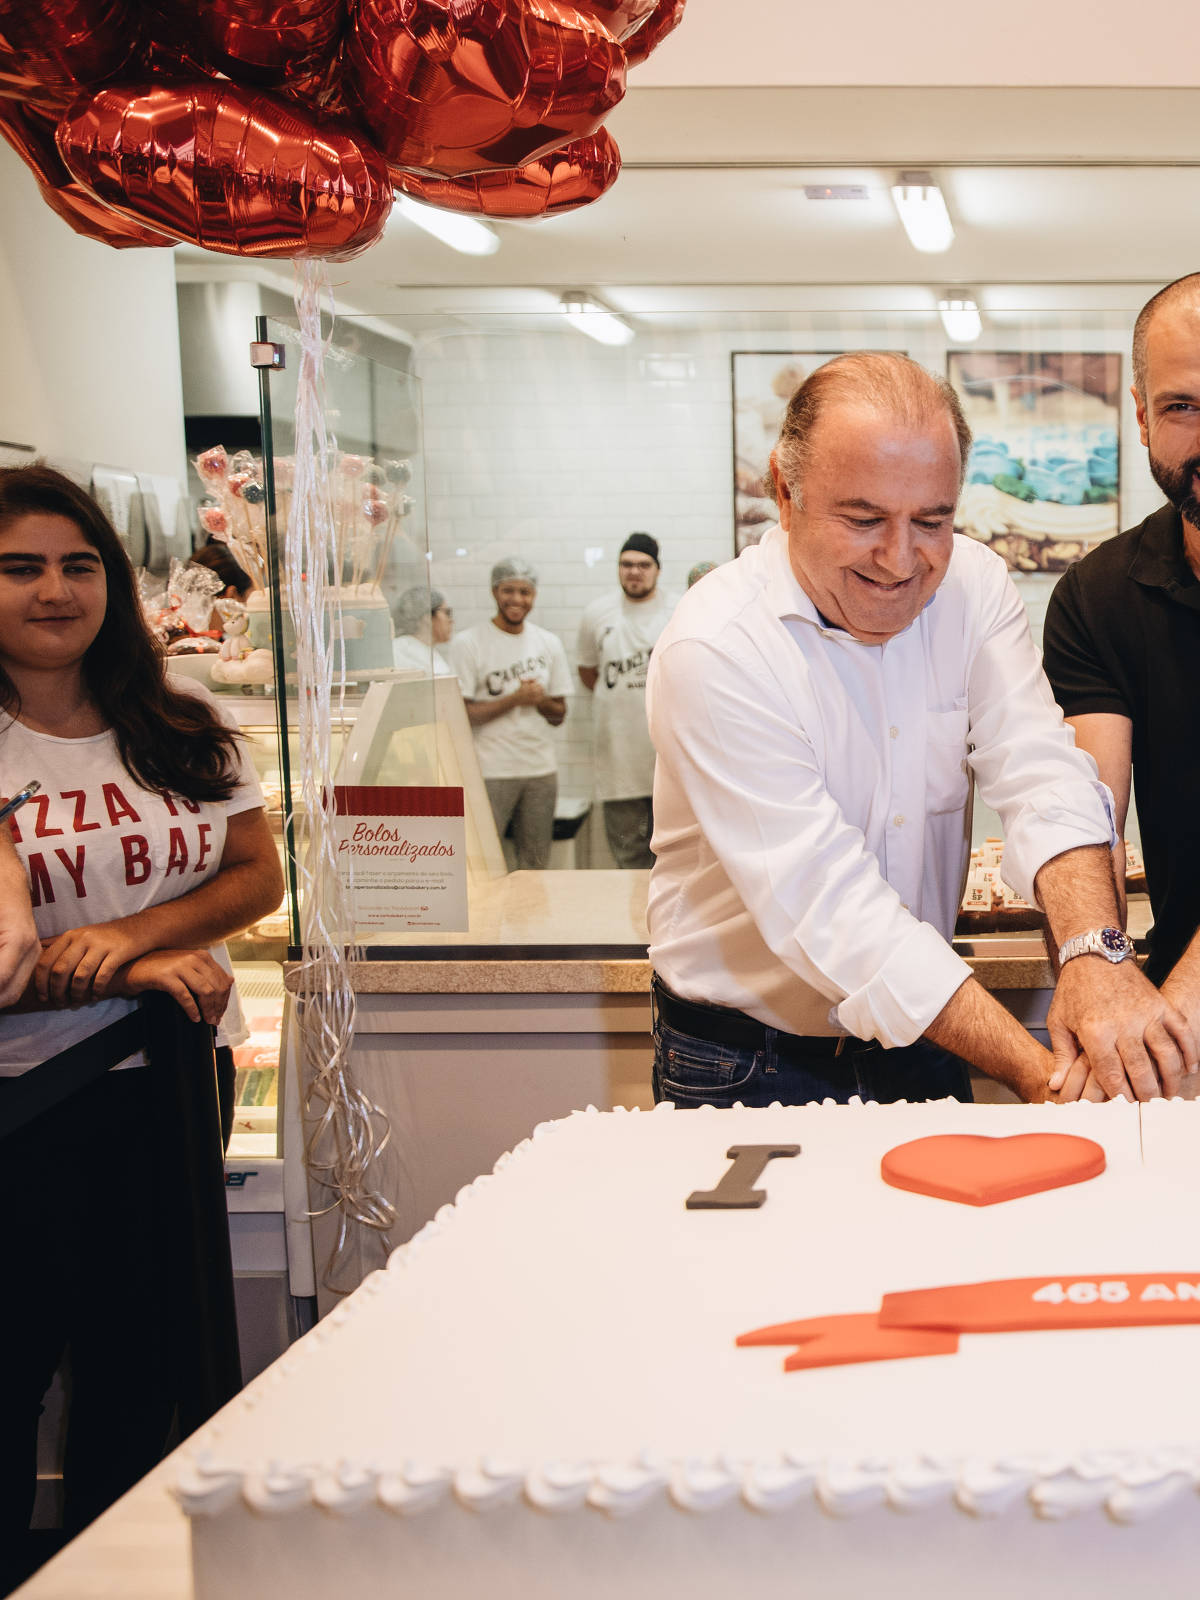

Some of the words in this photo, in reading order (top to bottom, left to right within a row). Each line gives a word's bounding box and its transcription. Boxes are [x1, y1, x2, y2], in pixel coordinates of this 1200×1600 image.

[0, 783, 142, 844] IZZA
[352, 821, 402, 842] Bolos
[120, 823, 212, 886] BAE
[685, 1143, 801, 1210] I
[1032, 1280, 1130, 1304] 465
